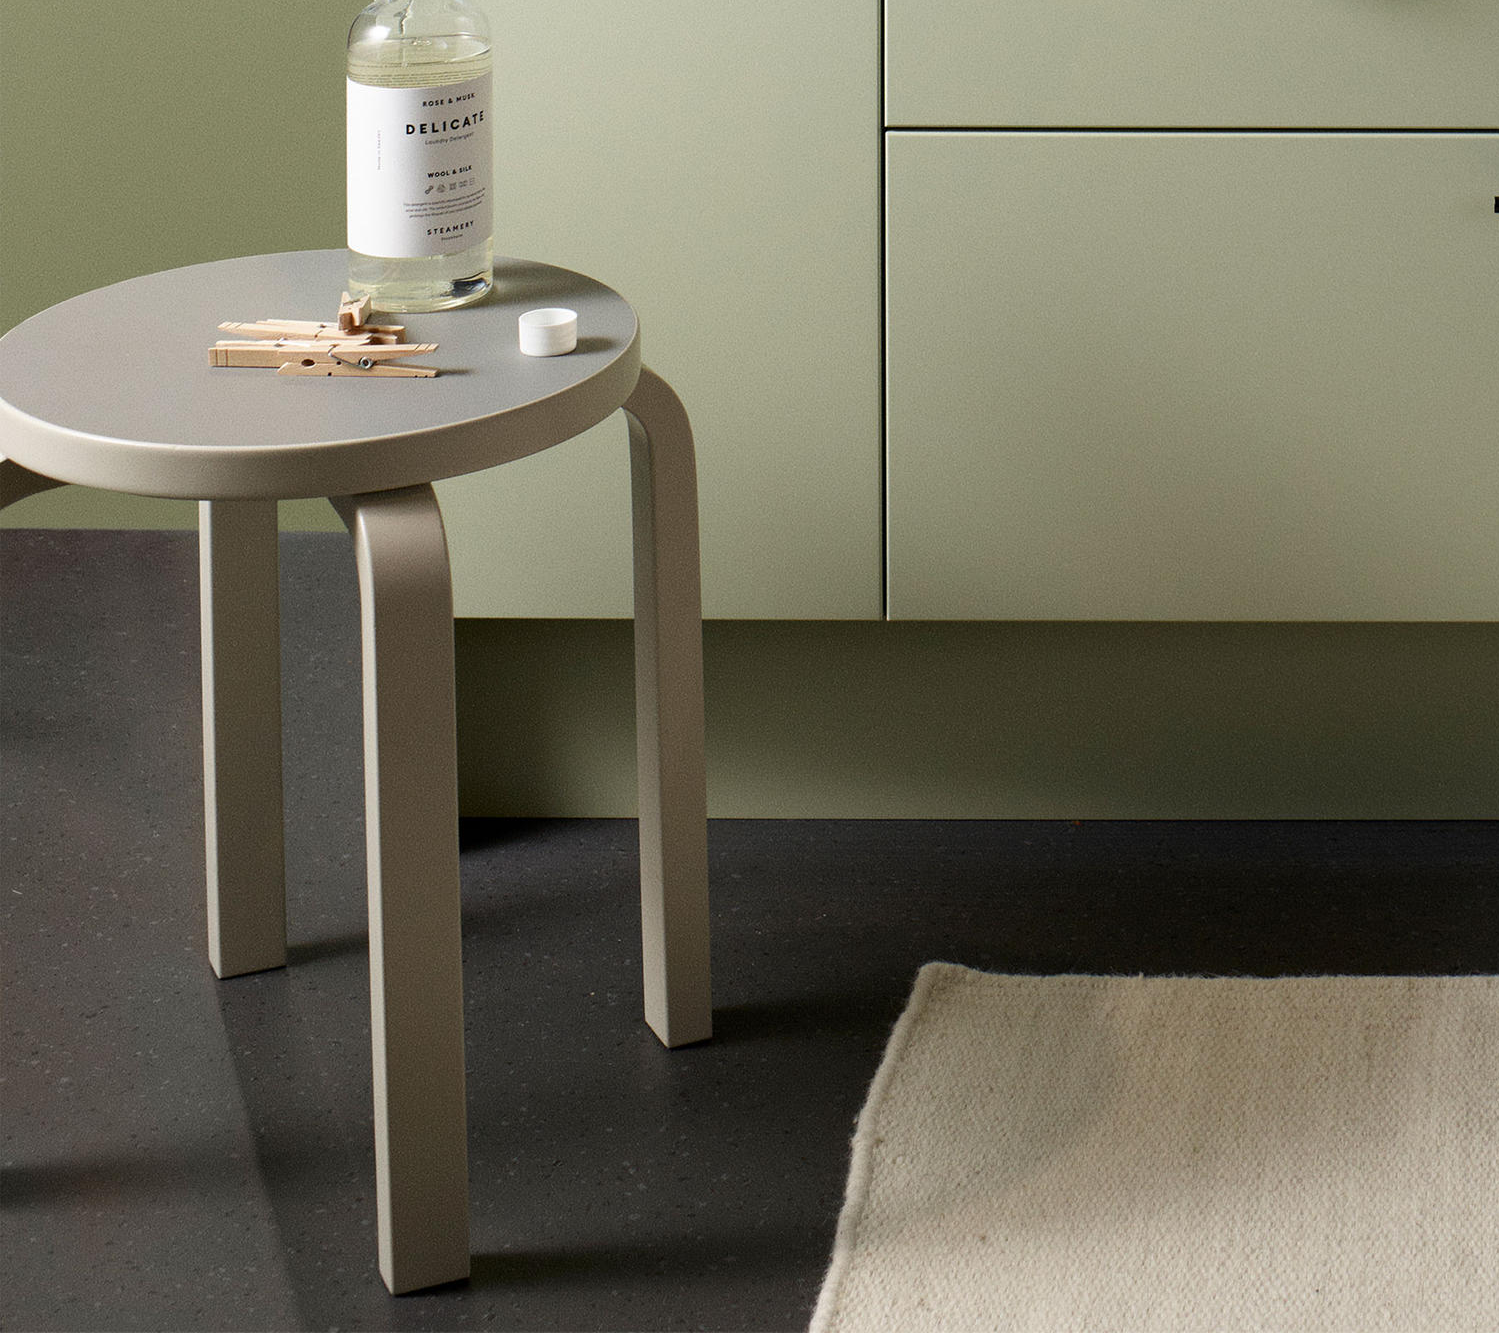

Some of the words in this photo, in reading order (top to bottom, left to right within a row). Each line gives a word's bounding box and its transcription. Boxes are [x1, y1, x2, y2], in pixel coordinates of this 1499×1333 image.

[422, 99, 444, 107] ROSE
[447, 96, 454, 105] &
[456, 93, 475, 102] MUSK
[406, 110, 484, 135] DELICATE
[452, 168, 458, 176] &
[459, 165, 473, 173] SILK
[427, 220, 474, 236] STEAMERY
